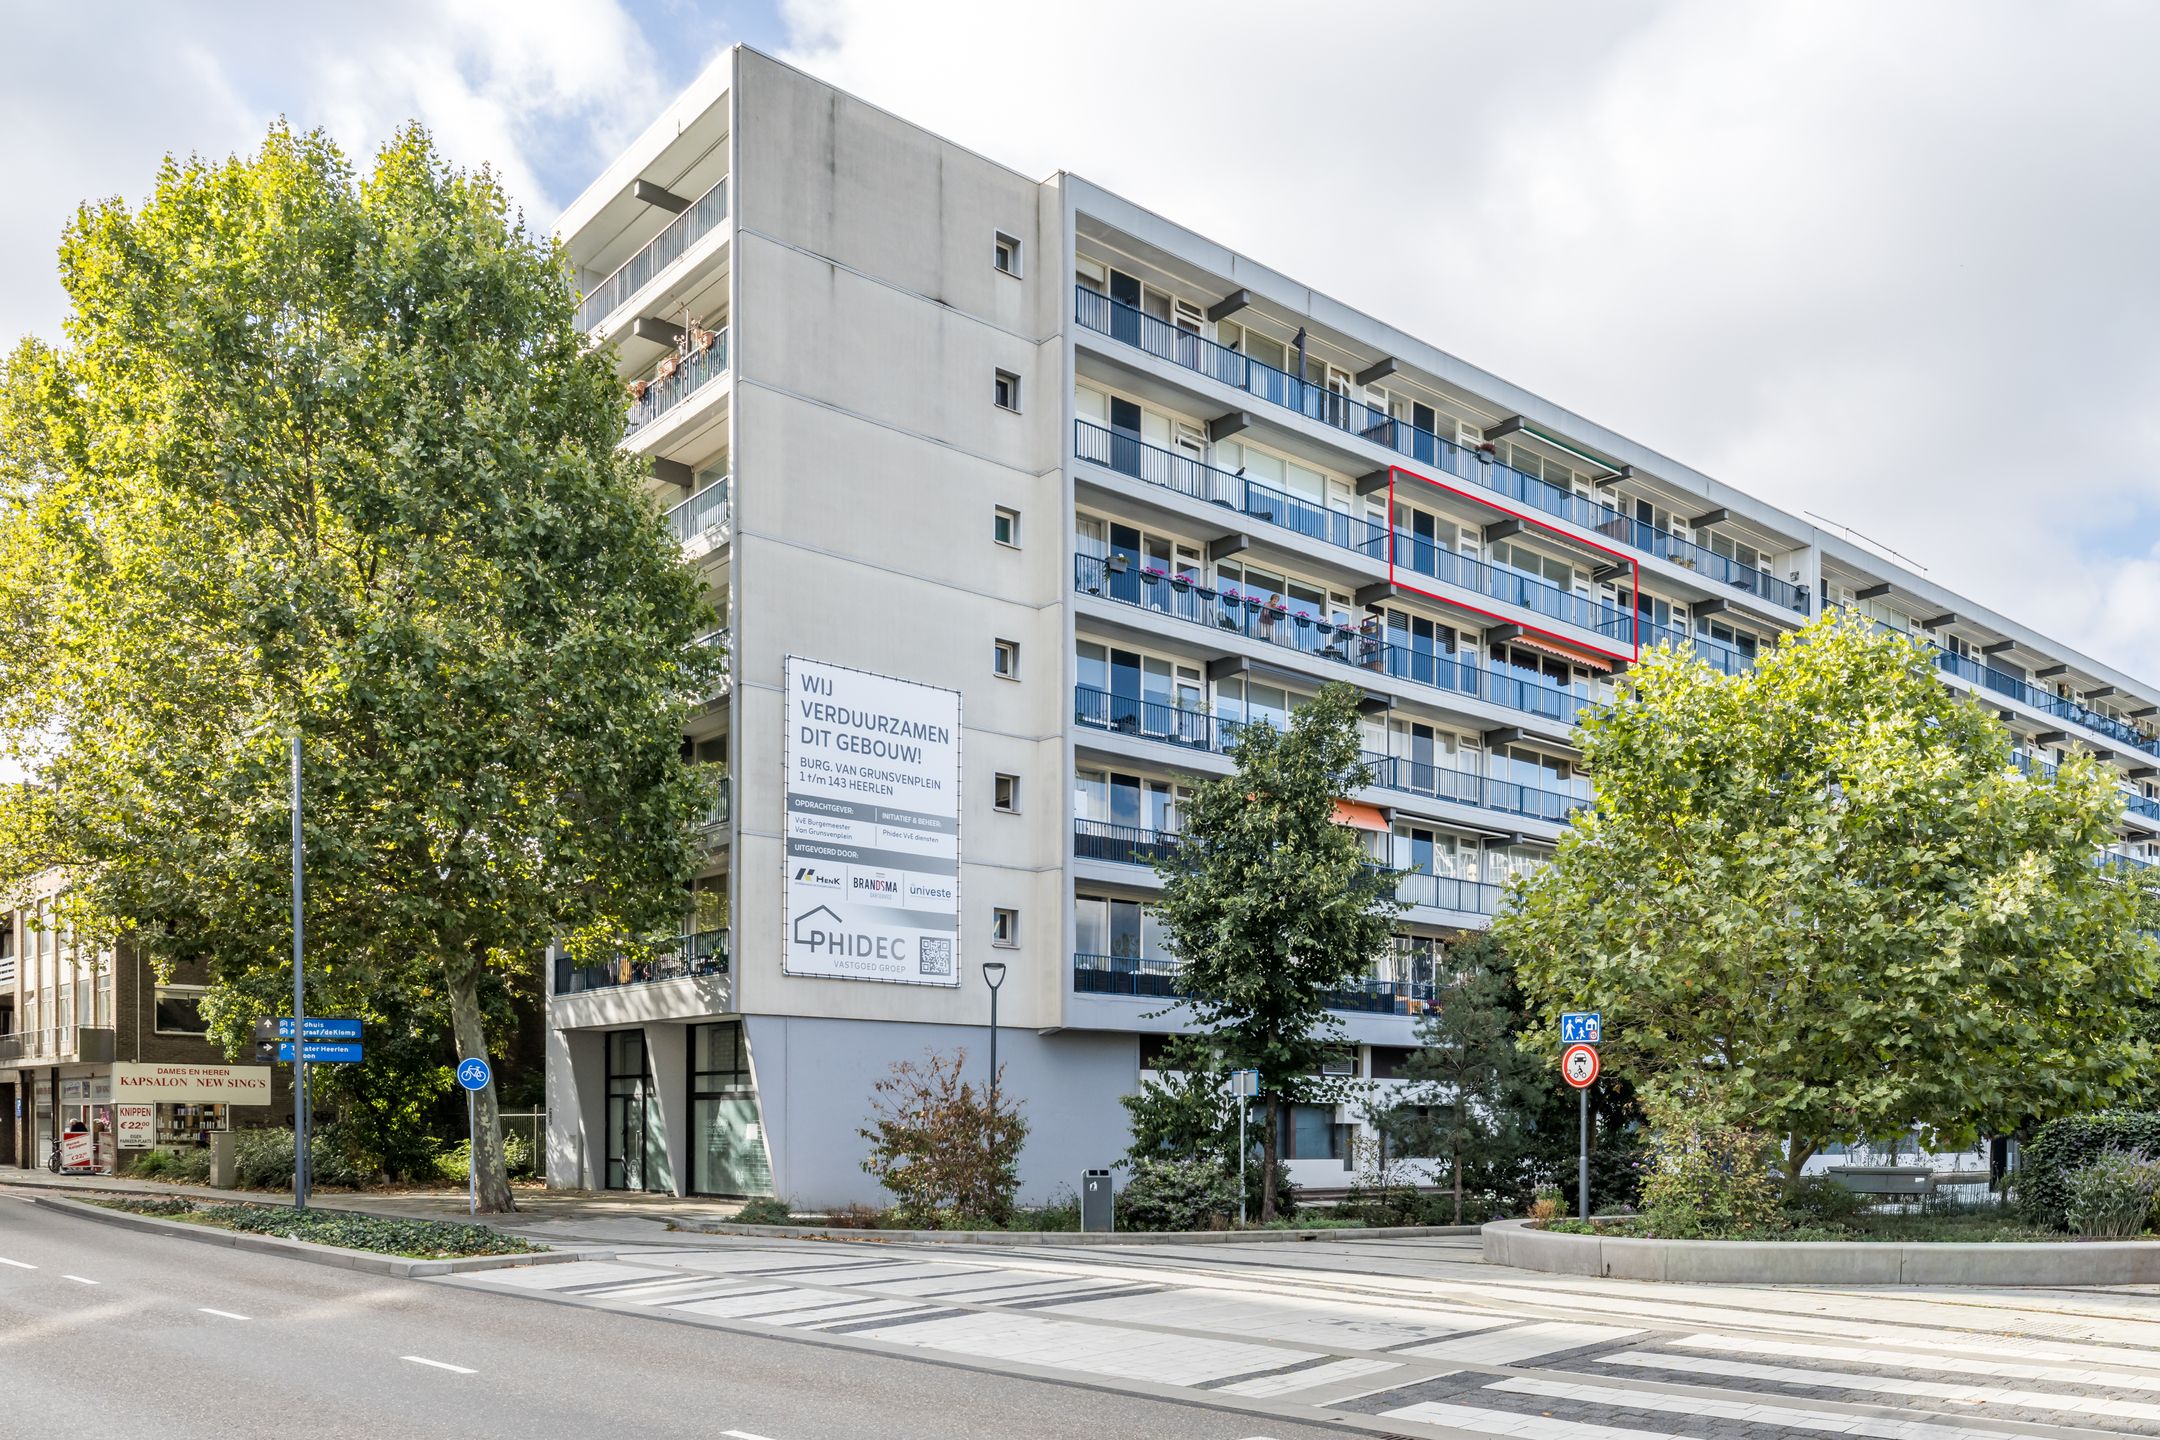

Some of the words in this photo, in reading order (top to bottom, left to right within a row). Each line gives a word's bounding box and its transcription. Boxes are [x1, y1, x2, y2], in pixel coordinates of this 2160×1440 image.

[801, 673, 833, 697] WIJ
[801, 699, 949, 745] VERDUURZAMEN
[801, 726, 831, 748] DIT
[836, 733, 922, 764] GEBOUW!
[800, 756, 833, 772] BURG.
[835, 762, 857, 776] VAN
[859, 767, 941, 790] GRUNSVENPLEIN
[800, 771, 804, 782] 1
[807, 771, 826, 785] t/m
[828, 776, 847, 788] 143
[849, 779, 894, 796] HEERLEN
[794, 799, 854, 815] OPDRACHTGEVER:
[808, 828, 852, 841] Grunsvenplein
[794, 843, 836, 856] UITGEVOERD
[837, 848, 859, 859] DOOR:
[853, 877, 897, 893] BRANDSMA
[810, 930, 906, 960] PHIDEC
[834, 960, 877, 971] VASTGOED
[879, 965, 906, 973] GROEP
[157, 1067, 186, 1075] DAMES
[120, 1076, 187, 1087] KAPSALON
[196, 1078, 224, 1088] NEW
[119, 1107, 151, 1117] KNIPPEN
